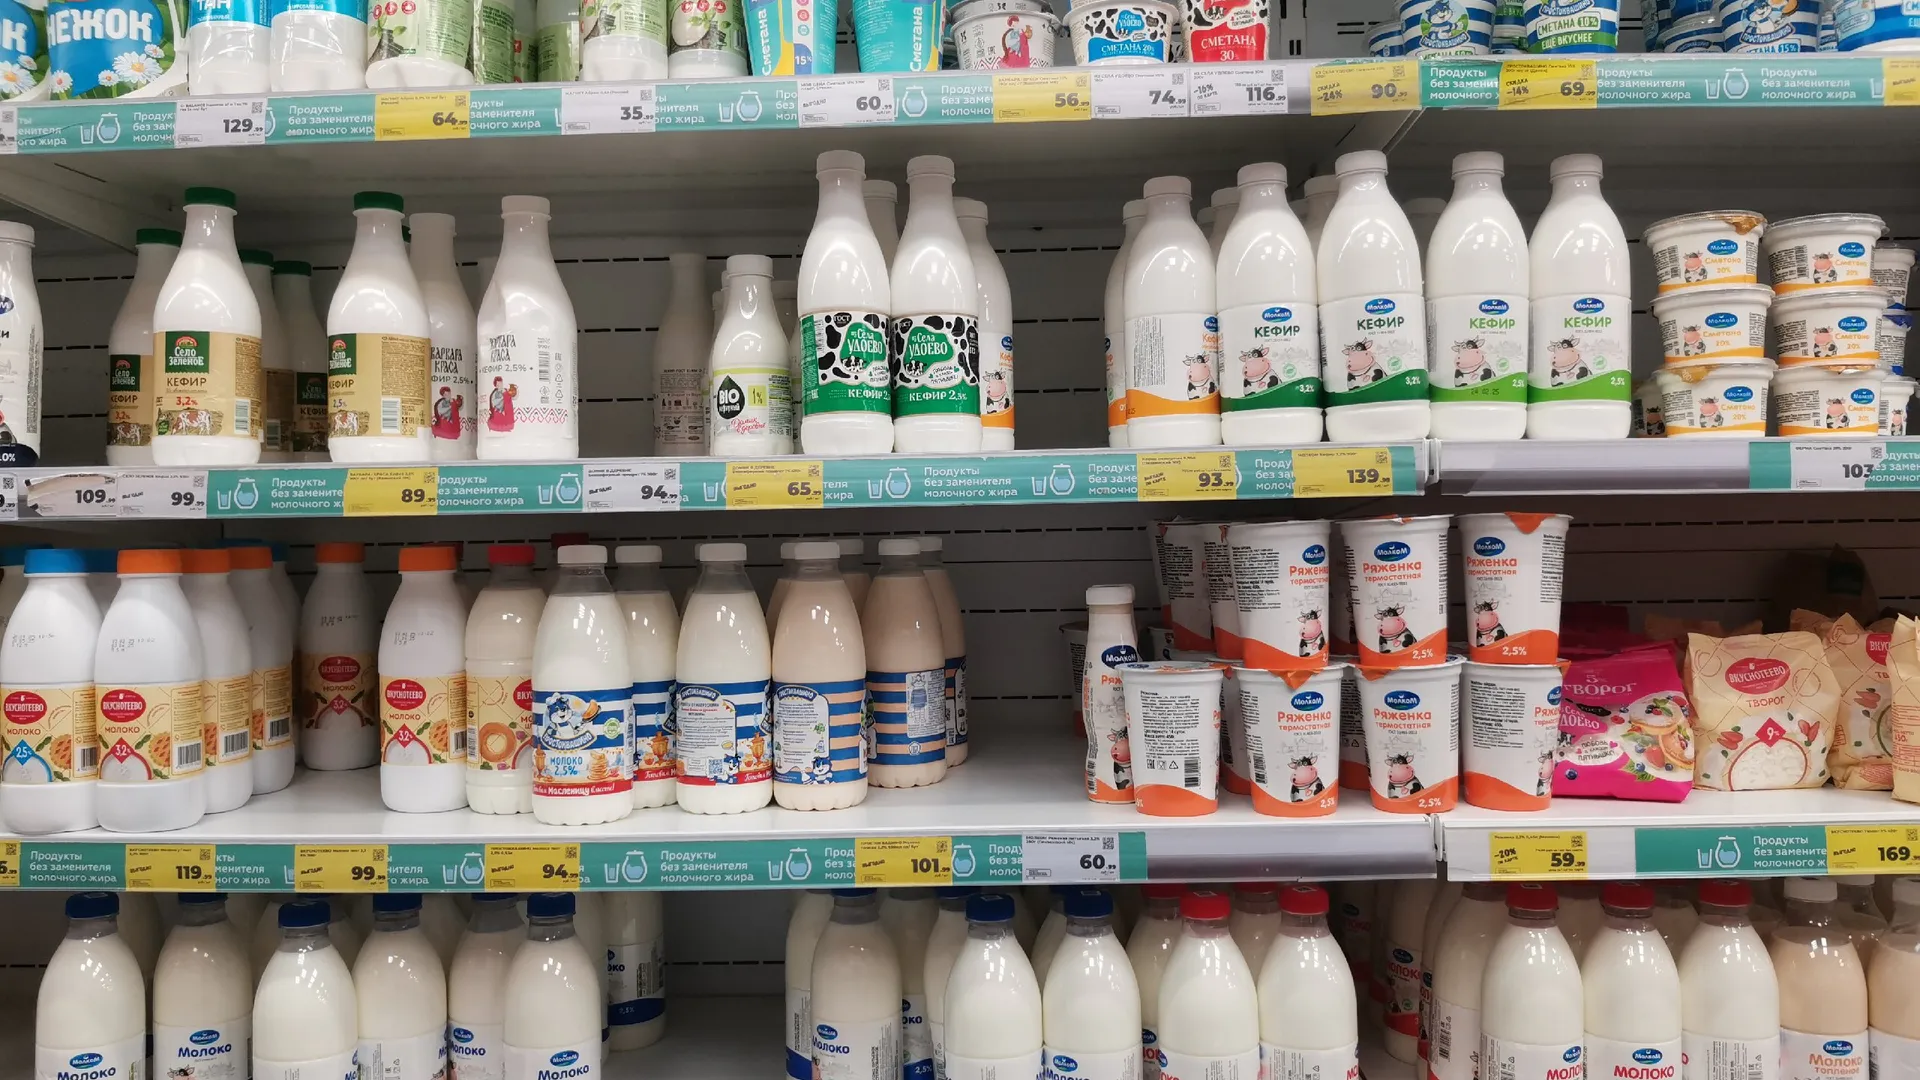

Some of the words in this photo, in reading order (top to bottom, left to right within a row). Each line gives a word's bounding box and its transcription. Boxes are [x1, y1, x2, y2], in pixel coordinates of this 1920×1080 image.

[1537, 17, 1575, 36] СМЕТАНА
[1578, 17, 1598, 27] 10%
[1201, 35, 1256, 48] СМЕТАНА
[1101, 43, 1141, 53] СМЕТАНА
[1430, 67, 1487, 79] Продукты
[1761, 68, 1817, 78] Продукты
[1430, 79, 1450, 88] без
[1619, 80, 1685, 88] заменителя
[1761, 79, 1780, 88] без
[1783, 79, 1850, 88] заменителя
[1430, 91, 1492, 100] молочного
[1661, 91, 1691, 100] жира
[1761, 91, 1823, 99] молочного
[1826, 90, 1857, 100] жира
[289, 106, 343, 115] Продукты
[288, 115, 308, 124] без
[309, 115, 374, 124] заменителя
[512, 119, 541, 129] жира
[675, 115, 705, 125] жира
[1357, 316, 1404, 331] КЕФИР
[1469, 317, 1515, 329] КЕФИР
[1564, 316, 1612, 328] КЕФИР
[857, 328, 874, 339] Села
[1254, 325, 1300, 338] КЕФИР
[917, 333, 935, 343] Села
[847, 339, 883, 354] УДОЕВО
[909, 342, 948, 358] УДОЕВО
[505, 362, 527, 372] 2,5%
[167, 377, 206, 387] КЕФИР
[1405, 376, 1421, 385] 3,2%
[1610, 376, 1625, 385] 2,5%
[1299, 384, 1314, 393] 3,2%
[848, 390, 883, 399] КЕФИР
[909, 392, 946, 401] КЕФИР
[176, 396, 198, 406] 3,2%
[924, 467, 980, 478] Продукты
[271, 477, 326, 488] Продукты
[924, 478, 942, 487] без
[945, 478, 1011, 487] заменителя
[271, 488, 290, 497] без
[454, 486, 518, 495] заменителя
[924, 488, 984, 498] молочного
[988, 488, 1018, 498] жира
[824, 491, 854, 501] жира
[271, 500, 333, 509] молочного
[494, 496, 524, 507] жира
[1467, 556, 1517, 568] Ряженка
[1362, 561, 1422, 574] Ряженка
[1364, 572, 1421, 583] термостатная
[1412, 649, 1433, 659] 2,5%
[1502, 645, 1526, 656] 2,5%
[1729, 665, 1786, 683] ВКУСНОТЕЕВО
[323, 684, 356, 692] МОЛОКО
[1564, 683, 1636, 696] ТВОРОГ
[386, 689, 423, 699] ВКУСНОТЕЕВО
[5, 702, 43, 712] ВКУСНОТЕЕВО
[103, 701, 143, 711] ВКУСНОТЕЕВО
[1746, 696, 1785, 708] ТВОРОГ
[389, 712, 421, 720] МОЛОКО
[1278, 710, 1331, 722] Ряженка
[1374, 709, 1431, 720] Ряженка
[104, 726, 140, 734] МОЛОКО
[1278, 722, 1331, 731] термостатная
[1376, 721, 1431, 730] термостатная
[7, 727, 41, 735] МОЛОКО
[550, 757, 583, 766] МОЛОКО
[554, 765, 577, 776] 2,5%
[548, 786, 590, 796] Масленицу
[1320, 798, 1335, 808] 2,5%
[1418, 798, 1441, 808] 2,5%
[1754, 836, 1808, 847] Продукты
[30, 851, 82, 862] Продукты
[660, 850, 716, 862] Продукты
[1754, 847, 1772, 856] без
[30, 862, 47, 871] без
[50, 862, 111, 871] заменителя
[660, 862, 679, 871] без
[682, 862, 748, 871] заменителя
[1754, 859, 1814, 868] молочного
[30, 873, 86, 883] молочного
[89, 874, 117, 884] жира
[242, 875, 270, 885] жира
[400, 875, 429, 885] жира
[660, 873, 722, 883] молочного
[724, 872, 754, 882] жира
[178, 1045, 232, 1058] Молоко
[1809, 1053, 1862, 1066] Молоко
[57, 1067, 116, 1080] Молоко
[538, 1065, 589, 1080] Молоко
[1614, 1065, 1675, 1080] МОЛОКО
